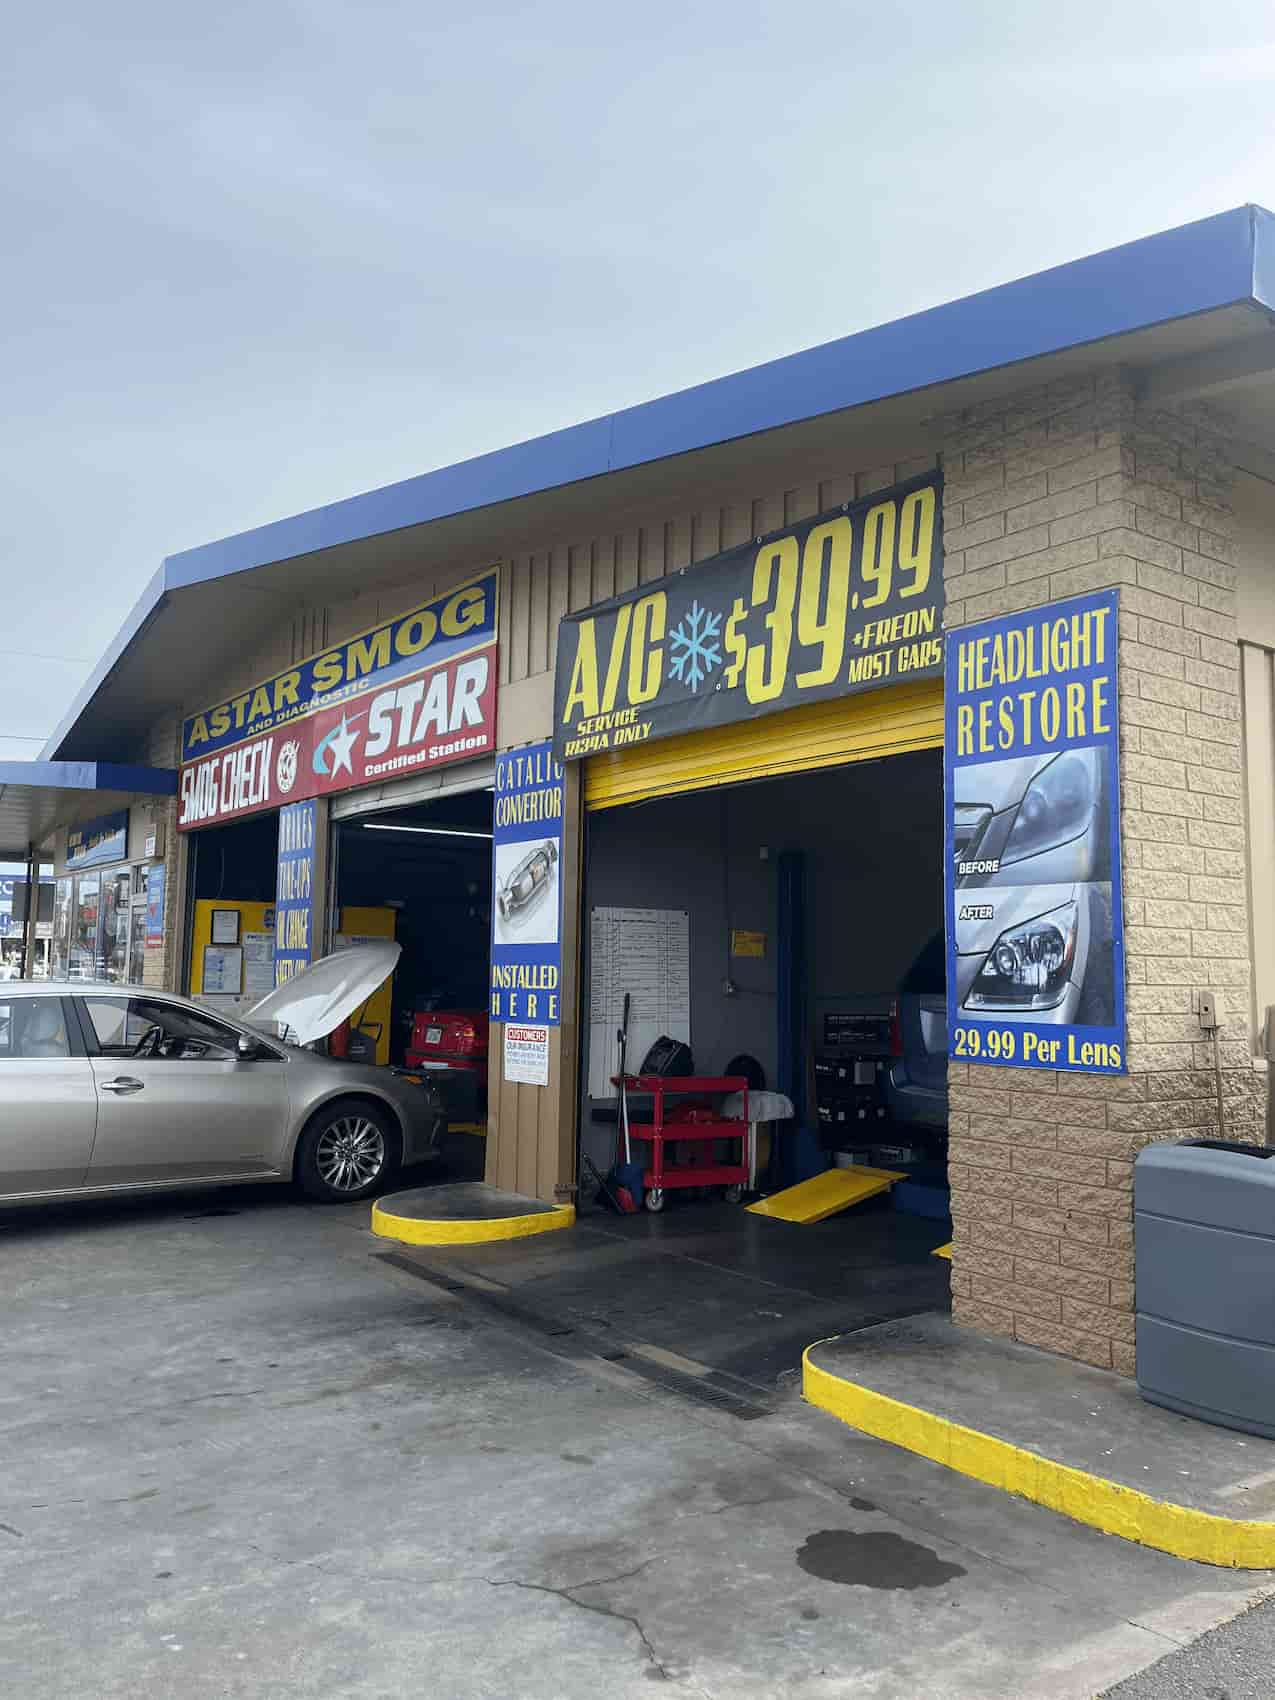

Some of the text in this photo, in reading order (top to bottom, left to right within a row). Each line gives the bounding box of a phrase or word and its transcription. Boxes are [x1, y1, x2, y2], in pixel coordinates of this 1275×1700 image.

[562, 486, 936, 724] A/C $39.99
[186, 586, 486, 748] ASTAR SMOG
[848, 637, 943, 685] MOST CARS
[957, 607, 1111, 694] HEADLIGHT
[247, 678, 369, 736] AND DIAGNOSTIC
[364, 656, 489, 758] STAR
[577, 707, 641, 737] SERVICE
[957, 676, 1111, 757] RESTORE
[613, 721, 653, 746] ONLY
[364, 733, 488, 778] Certified Station
[179, 737, 274, 825] SMOG CHECK
[495, 786, 562, 826] CONVERTOR
[959, 860, 1000, 875] BEFORE
[959, 905, 993, 920] AFTER
[492, 965, 558, 990] INSTALLED
[492, 992, 558, 1019] HERE
[508, 1029, 545, 1042] CUSTOMERS
[954, 1027, 1122, 1069] 29.99 Per Lens
